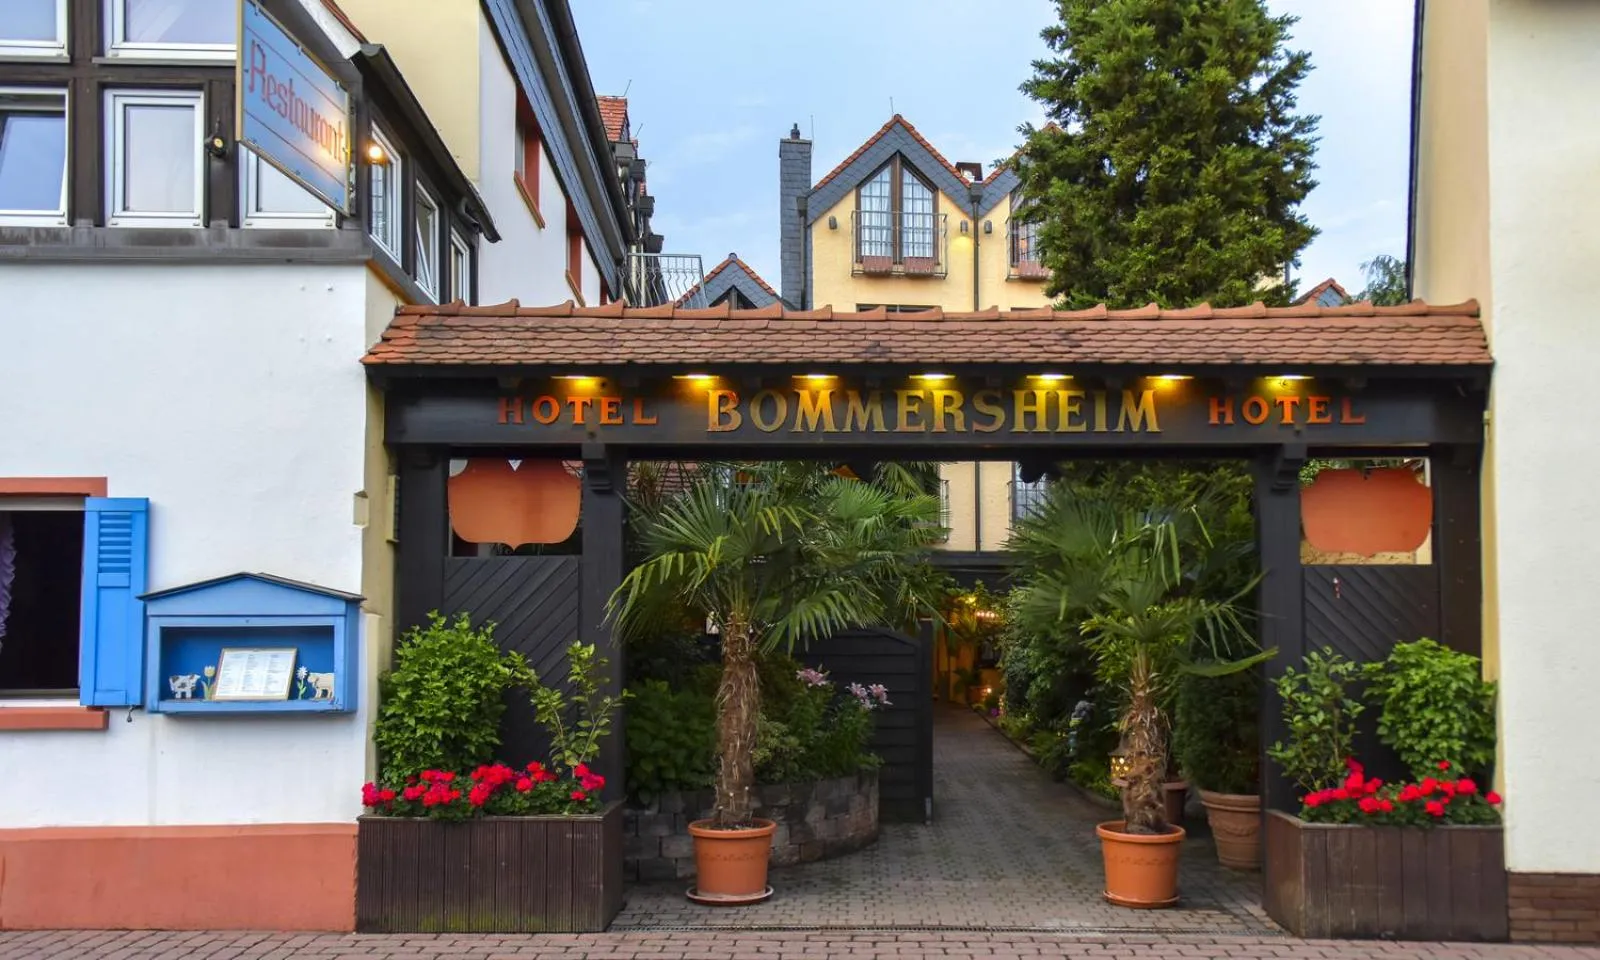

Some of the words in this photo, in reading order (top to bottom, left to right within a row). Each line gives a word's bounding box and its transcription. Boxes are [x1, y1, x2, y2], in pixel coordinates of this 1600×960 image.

[249, 39, 344, 163] Restaurant
[497, 396, 658, 425] HOTEL
[706, 389, 1161, 432] BOMMERSHEIM
[1208, 396, 1366, 425] HOTEL
